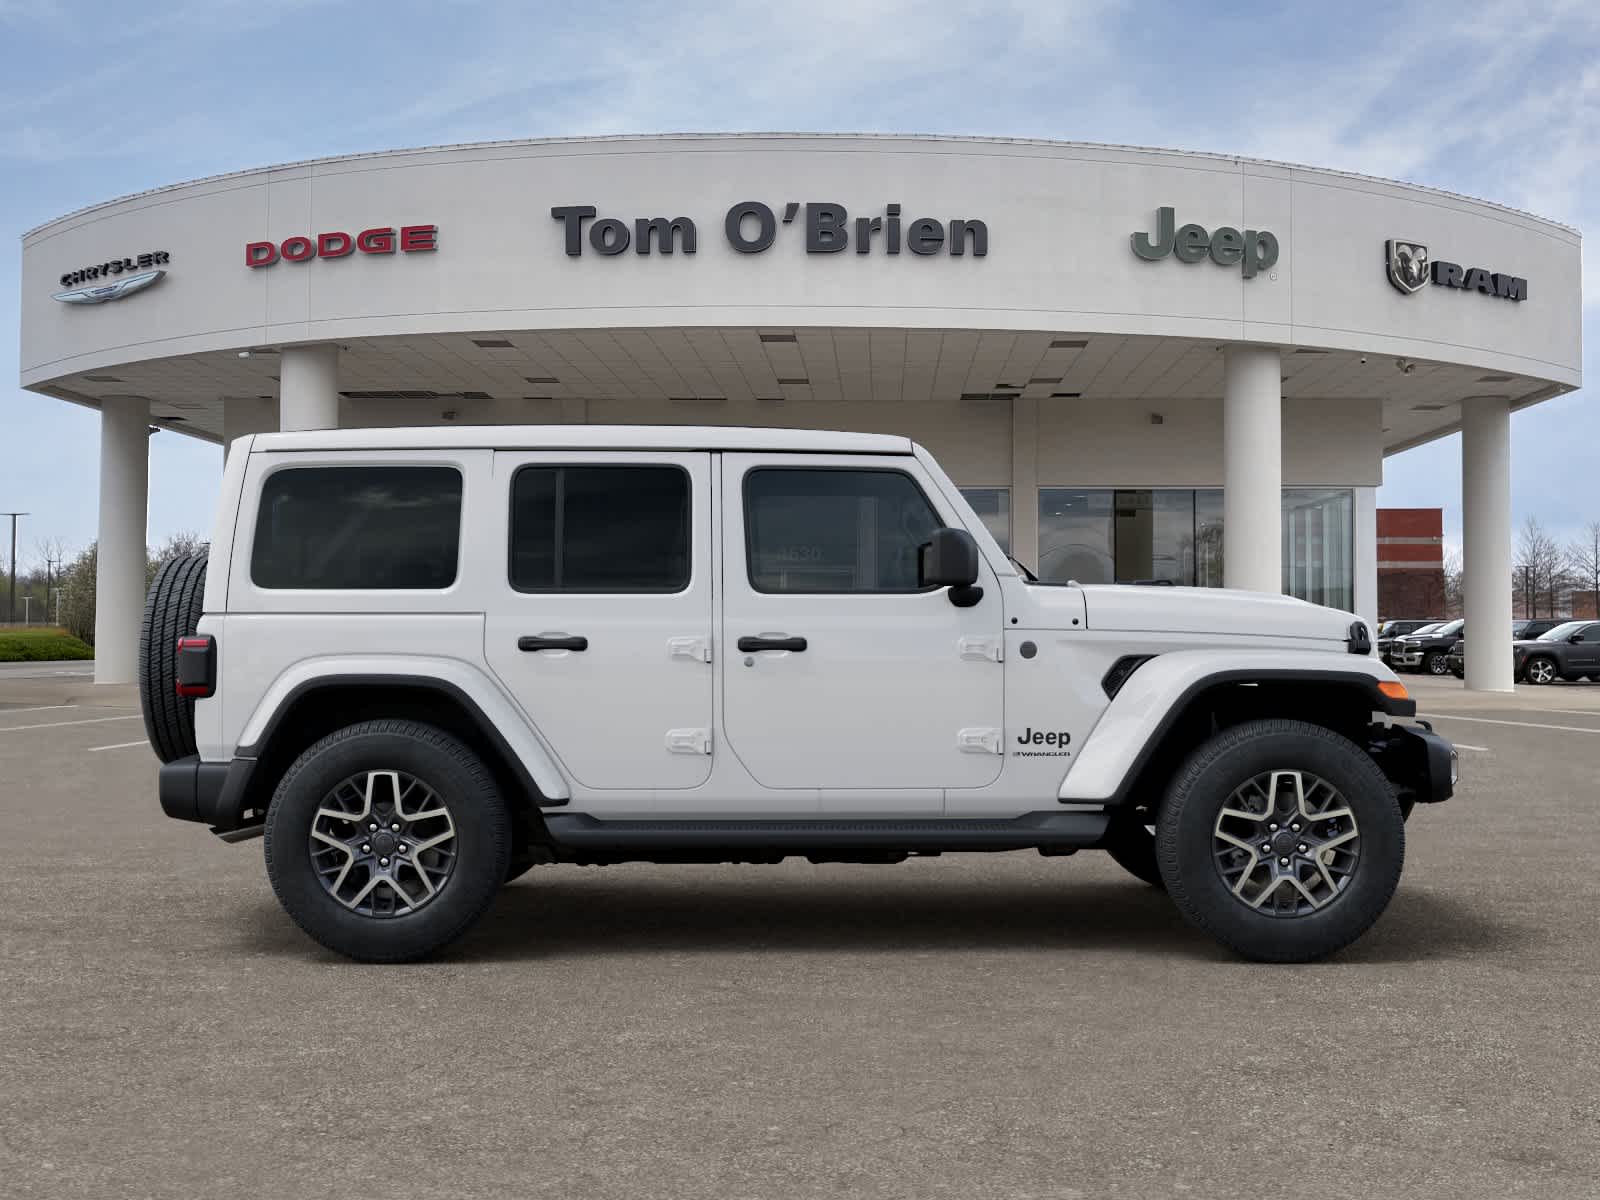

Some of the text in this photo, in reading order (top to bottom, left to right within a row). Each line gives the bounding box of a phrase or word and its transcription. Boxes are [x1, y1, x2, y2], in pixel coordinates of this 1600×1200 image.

[246, 225, 438, 268] DODGE
[551, 201, 988, 256] Tom O'Brien
[1131, 206, 1279, 279] Jeep
[60, 250, 169, 287] CHRYSLER
[1431, 260, 1527, 302] RAM
[1017, 727, 1071, 748] Jeep
